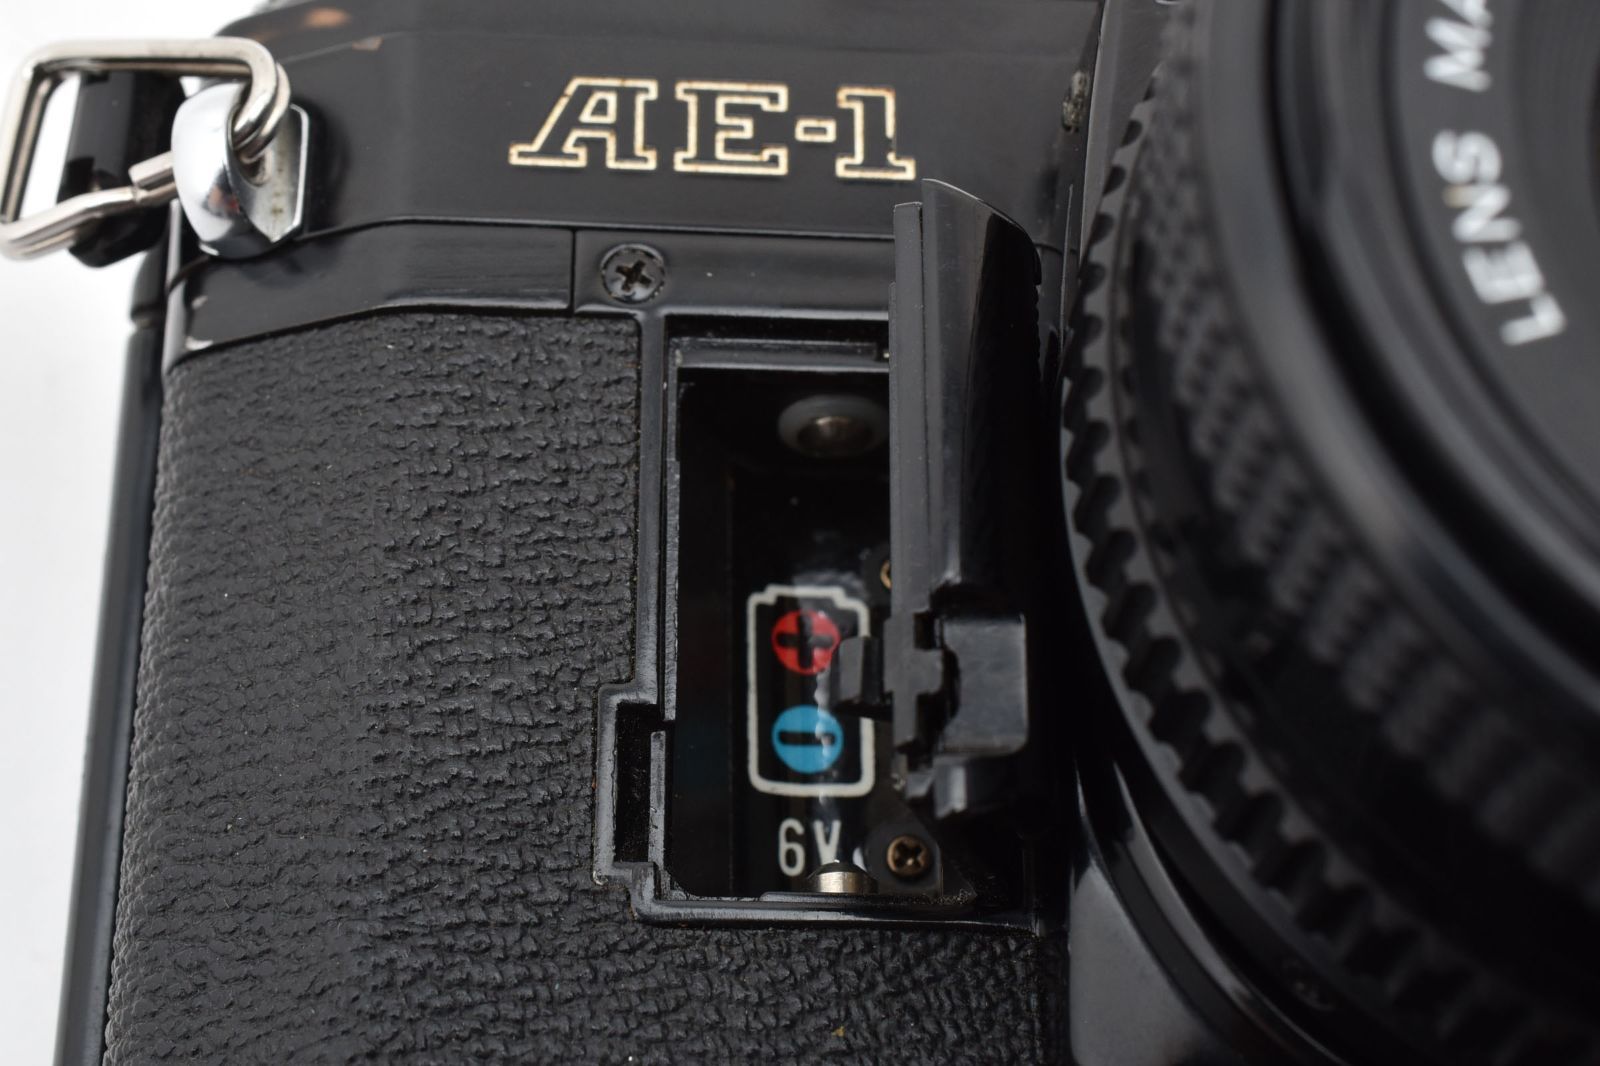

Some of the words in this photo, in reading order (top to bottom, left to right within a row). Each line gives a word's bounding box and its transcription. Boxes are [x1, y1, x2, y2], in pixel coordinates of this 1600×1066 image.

[509, 76, 917, 181] AE-1
[1431, 129, 1566, 346] LENS
[777, 818, 842, 877] 6V
